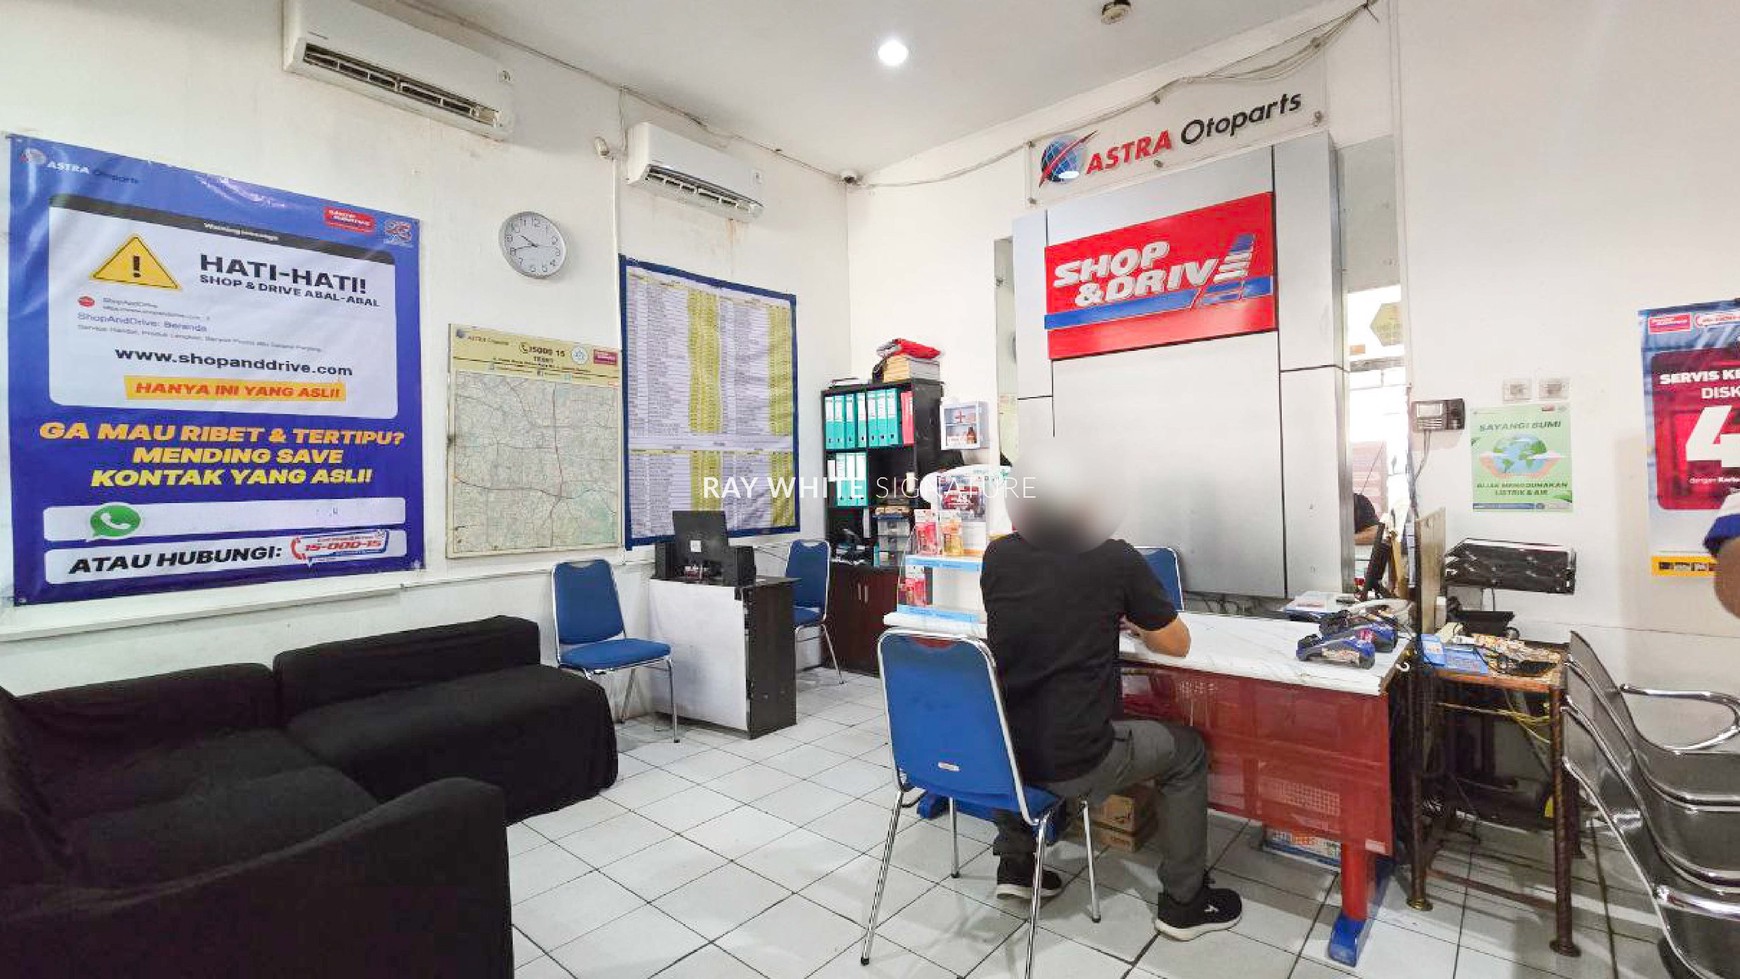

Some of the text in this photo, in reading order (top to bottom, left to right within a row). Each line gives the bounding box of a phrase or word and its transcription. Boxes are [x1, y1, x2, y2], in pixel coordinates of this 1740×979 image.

[1086, 92, 1302, 175] ASTRA Otoparts
[47, 160, 90, 175] ASTRA
[200, 254, 366, 295] HATI-HATI!
[1053, 240, 1171, 289] SHOP
[200, 274, 380, 307] SHOP & DRIVE ABAL-ABAL
[77, 311, 208, 333] ShopAndDrive: Beranda
[114, 347, 354, 377] www.shopanddrive.com
[1659, 370, 1720, 386] SERVIS
[135, 382, 341, 399] HANYA INI YANG ASLI!
[1701, 386, 1740, 400] DISK
[39, 421, 405, 446] GA MAU RIBET & TERTIPU?
[1479, 420, 1562, 432] SAYANGI BUMI
[132, 447, 345, 465] MENDING SAVE
[90, 467, 374, 488] KONTAK YANG ASLI!
[305, 540, 382, 552] 15-000-15
[68, 544, 283, 575] ATAU HUBUNGI:
